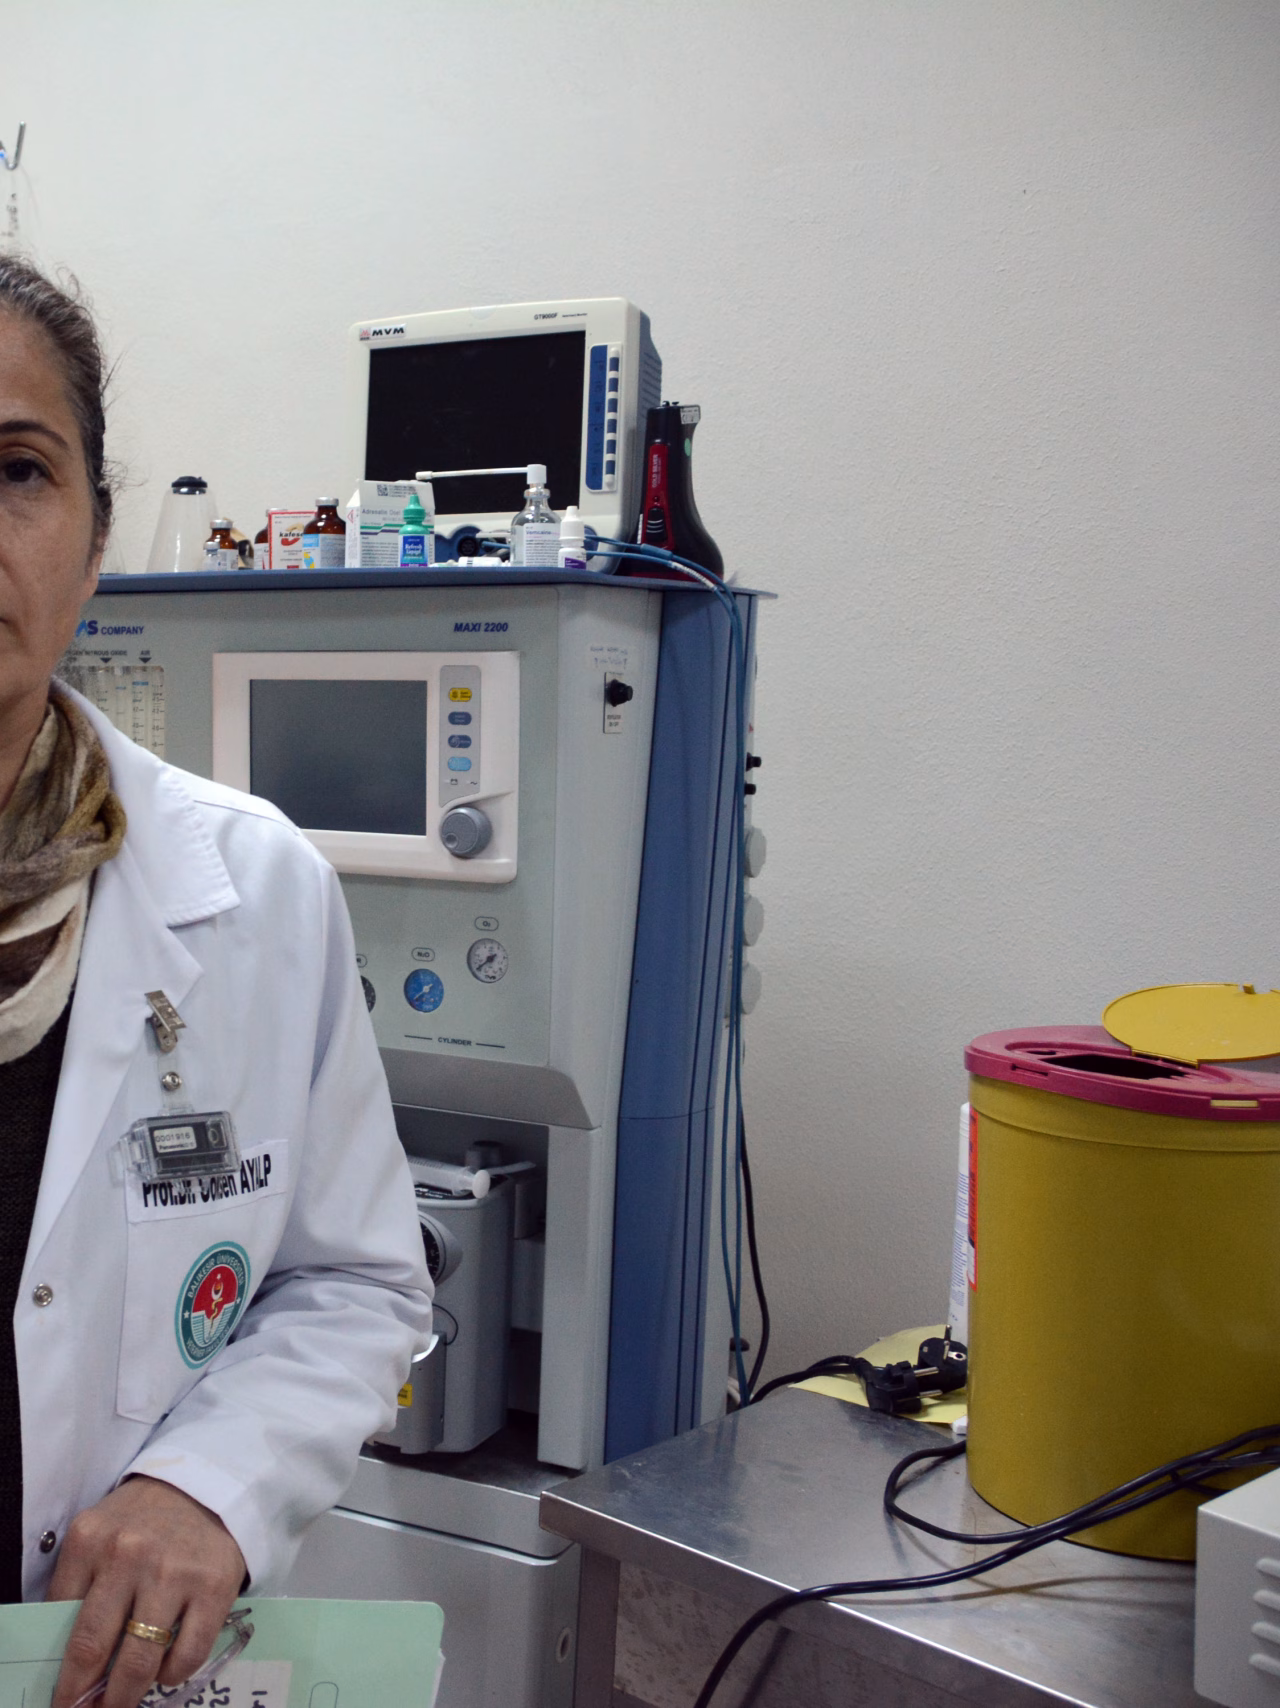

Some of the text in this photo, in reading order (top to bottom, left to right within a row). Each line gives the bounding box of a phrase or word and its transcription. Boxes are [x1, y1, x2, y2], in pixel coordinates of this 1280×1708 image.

[371, 327, 404, 336] MVM
[101, 626, 145, 636] COMPANY
[453, 622, 509, 632] MAXI 2200
[438, 1037, 472, 1046] CYLINDER
